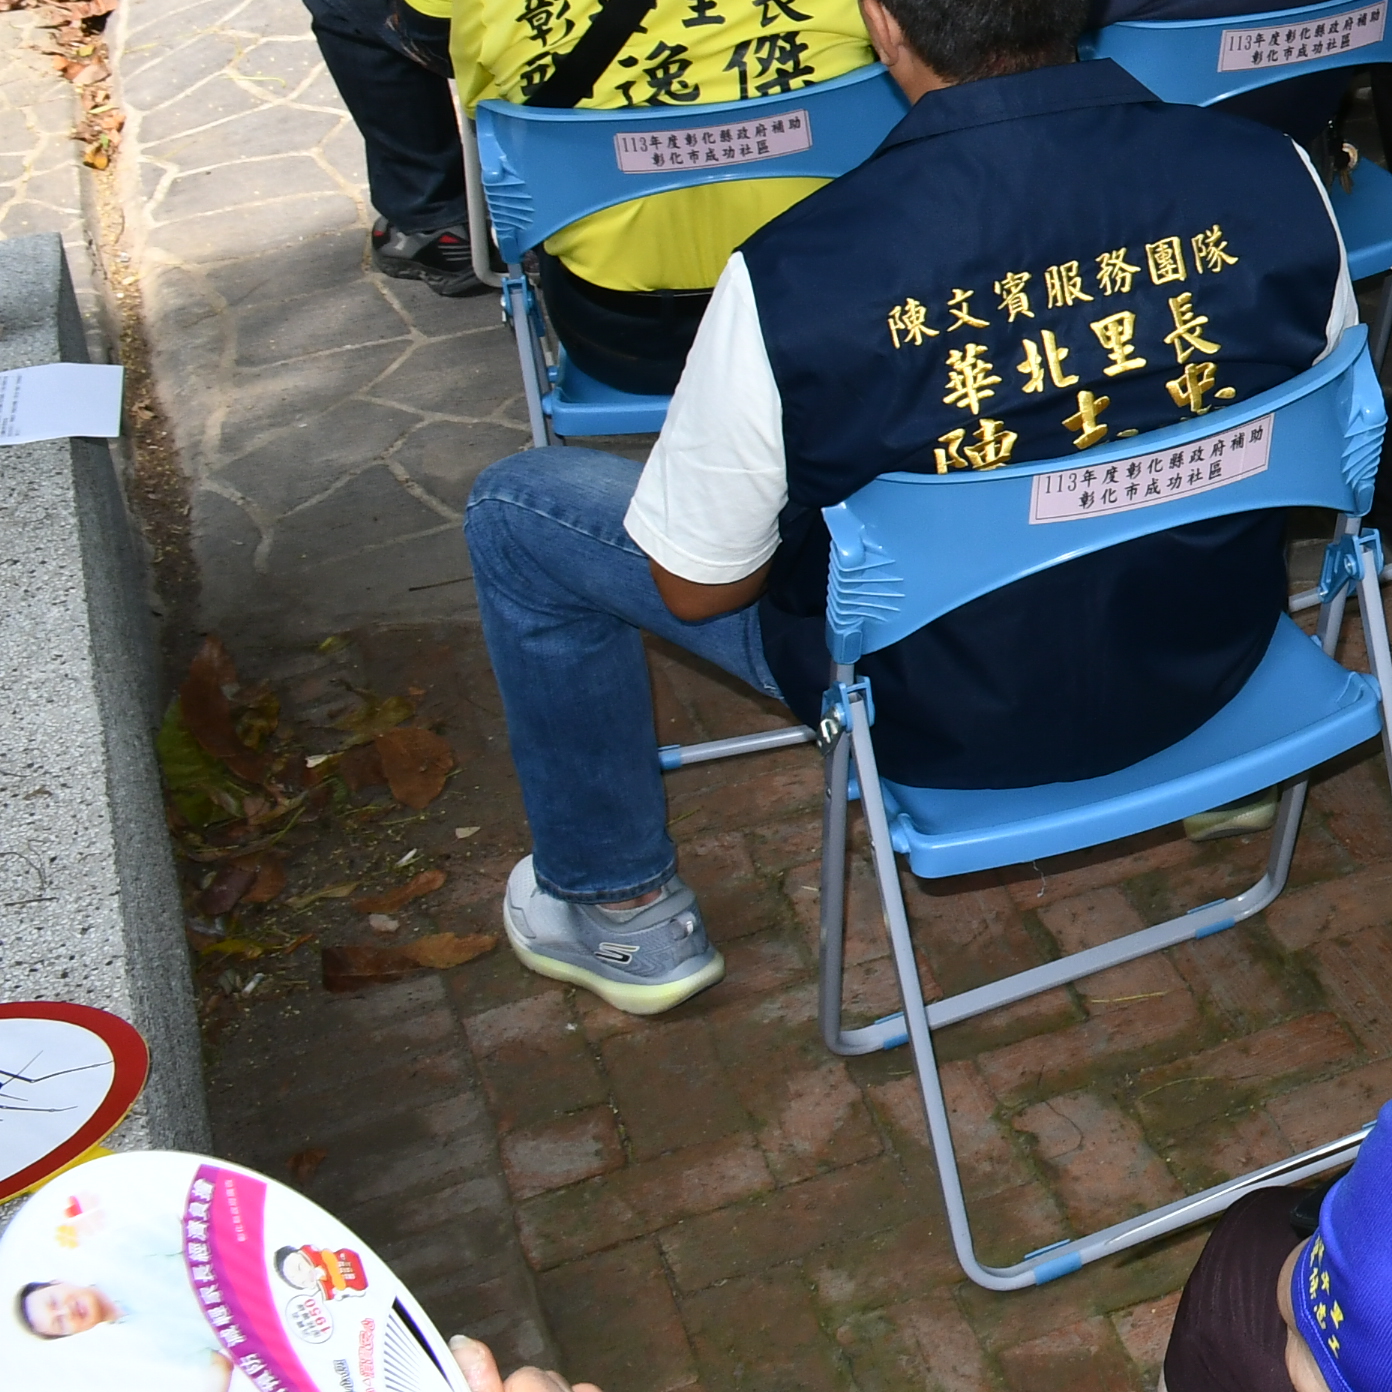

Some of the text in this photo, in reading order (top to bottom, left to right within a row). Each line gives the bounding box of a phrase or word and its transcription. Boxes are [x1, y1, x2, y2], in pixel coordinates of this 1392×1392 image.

[1229, 9, 1381, 51] 113年度彰化縣政府補助
[1251, 35, 1351, 64] 彰化市成功社區
[621, 118, 801, 154] 113年度彰化縣政府補助
[651, 140, 770, 167] 彰化市成功社區
[887, 224, 1238, 349] 陳文賓服務團隊
[943, 292, 1221, 415] 華北里長
[1044, 425, 1264, 495] 113年度彰化縣政府補助
[1078, 461, 1223, 510] 彰化市成功社區
[304, 1298, 332, 1334] 1950
[239, 1353, 287, 1392] 預防
